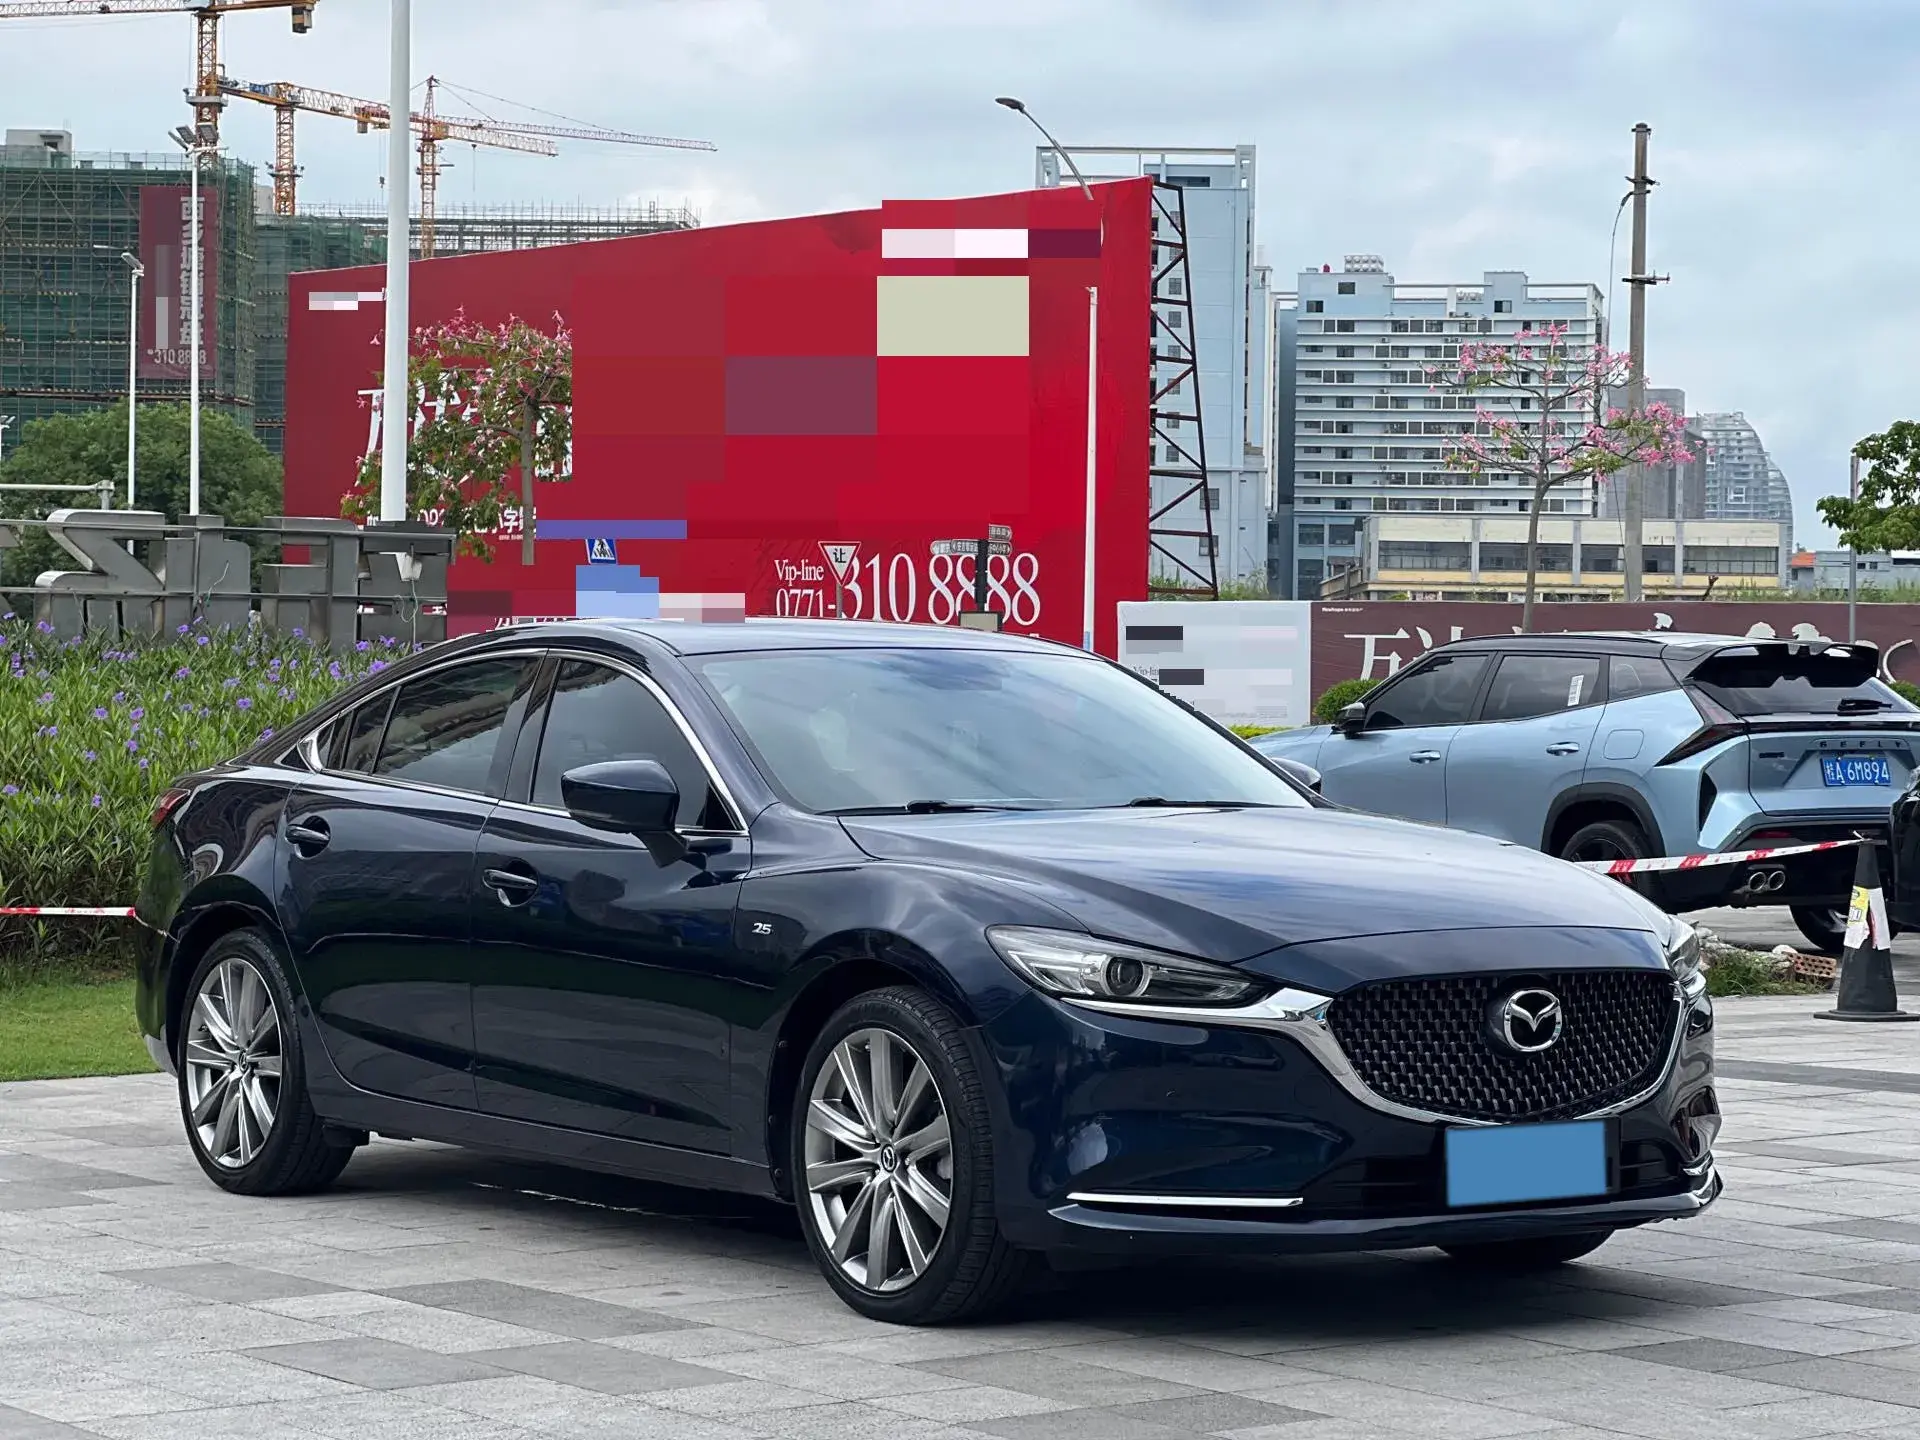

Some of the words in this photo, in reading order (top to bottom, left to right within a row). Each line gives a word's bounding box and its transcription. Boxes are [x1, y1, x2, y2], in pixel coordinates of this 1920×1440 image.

[177, 349, 207, 364] 888
[833, 548, 847, 563] 让
[774, 559, 824, 587] Vip-line
[752, 922, 772, 935] 25
